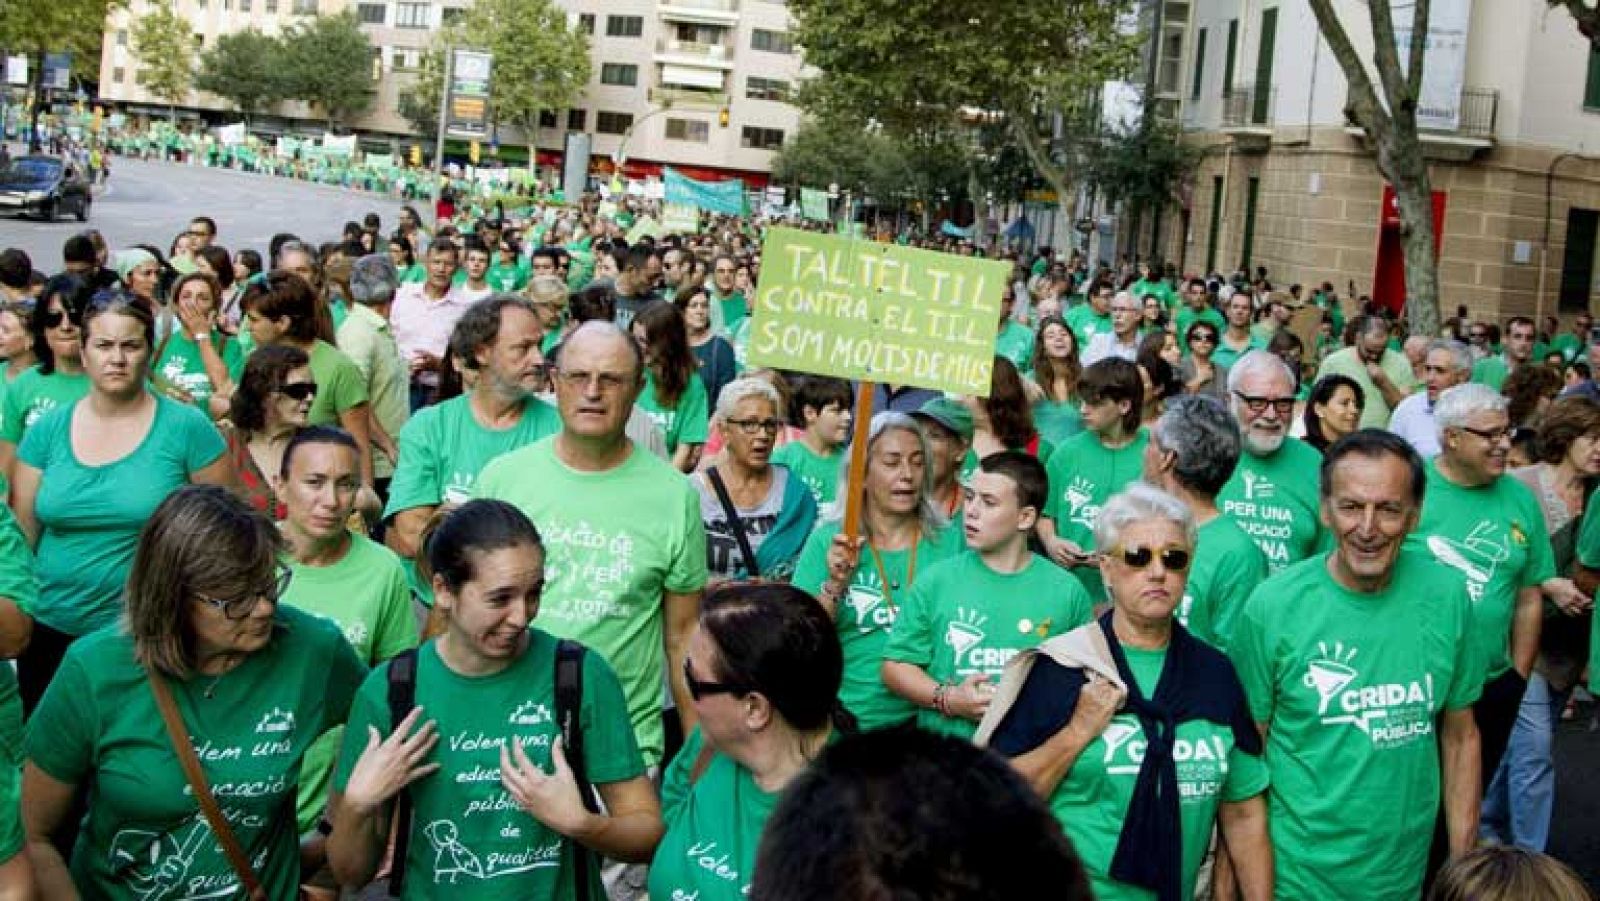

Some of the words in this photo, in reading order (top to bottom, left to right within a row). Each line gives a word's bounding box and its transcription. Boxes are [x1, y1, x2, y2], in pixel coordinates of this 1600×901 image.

[926, 267, 993, 312] TIL
[763, 285, 868, 322] CONTRA
[884, 304, 918, 335] EL
[756, 321, 825, 362] SOM
[913, 346, 945, 380] DE
[1225, 500, 1257, 518] PER
[1262, 504, 1293, 522] UNA
[1341, 672, 1434, 712] CRIDA!
[251, 739, 291, 757] una
[450, 730, 506, 751] Volem
[1127, 735, 1229, 774] CDA!
[501, 822, 521, 838] de
